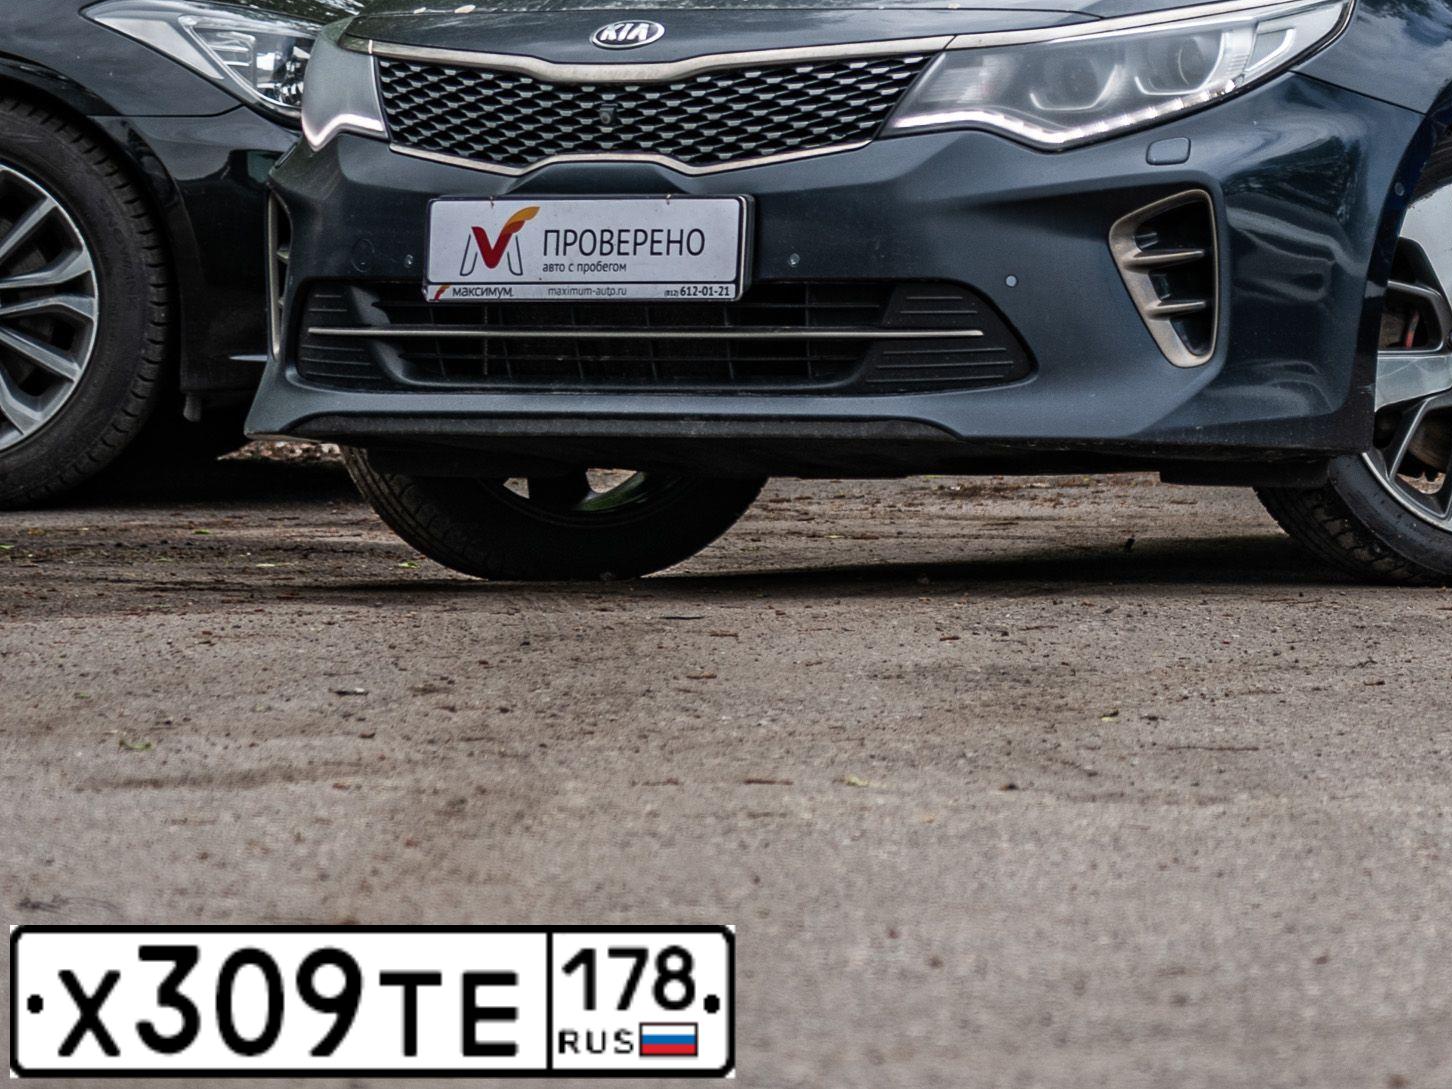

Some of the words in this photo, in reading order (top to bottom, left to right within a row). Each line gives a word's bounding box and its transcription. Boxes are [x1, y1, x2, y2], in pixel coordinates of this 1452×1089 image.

[600, 23, 650, 41] KIA
[543, 228, 705, 257] ПРОВЕРЕНО
[542, 263, 566, 273] авто
[568, 263, 574, 273] с
[577, 260, 627, 275] пробегом
[548, 286, 627, 297] maximum-auto.ru
[680, 286, 730, 297] 612-01-21
